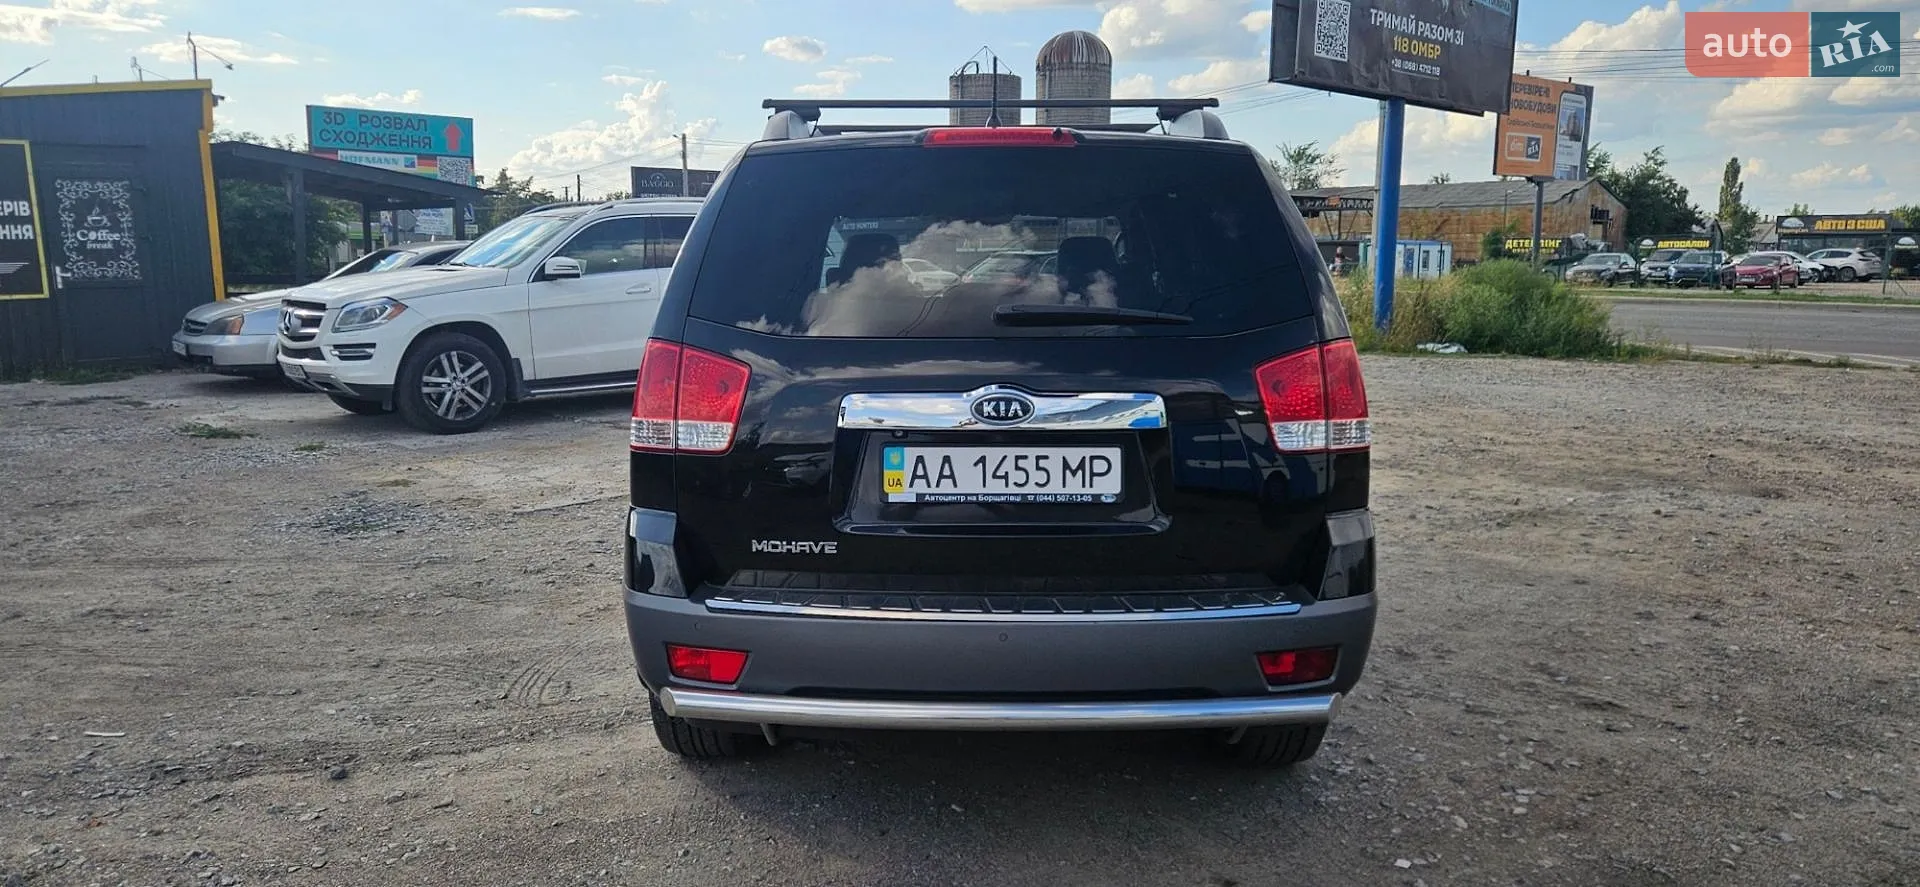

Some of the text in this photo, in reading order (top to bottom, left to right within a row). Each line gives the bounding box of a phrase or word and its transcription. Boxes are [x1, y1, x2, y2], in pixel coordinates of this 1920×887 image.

[1370, 9, 1465, 47] ТРИМАЙ РАЗОМ ЗІ
[1393, 35, 1441, 59] 118 ОМБР
[323, 111, 428, 132] 3D РОЗВАЛ
[319, 128, 433, 150] СХОДЖЕННЯ
[641, 179, 674, 189] BAGGIO
[1814, 219, 1846, 231] АВТО
[1856, 219, 1886, 230] США
[76, 229, 121, 241] Coffee
[86, 240, 114, 249] break
[1504, 238, 1562, 250] ДЕТЕЛІНГ
[1657, 239, 1710, 249] АВТОСАЛОН
[982, 400, 1024, 418] KIA
[908, 454, 1113, 489] AA 1455 MP
[887, 478, 903, 489] UA
[924, 494, 966, 504] Автоцентр
[1036, 494, 1055, 503] (044)
[1056, 494, 1092, 502] 507-13-05
[751, 539, 838, 554] MOHAVE
